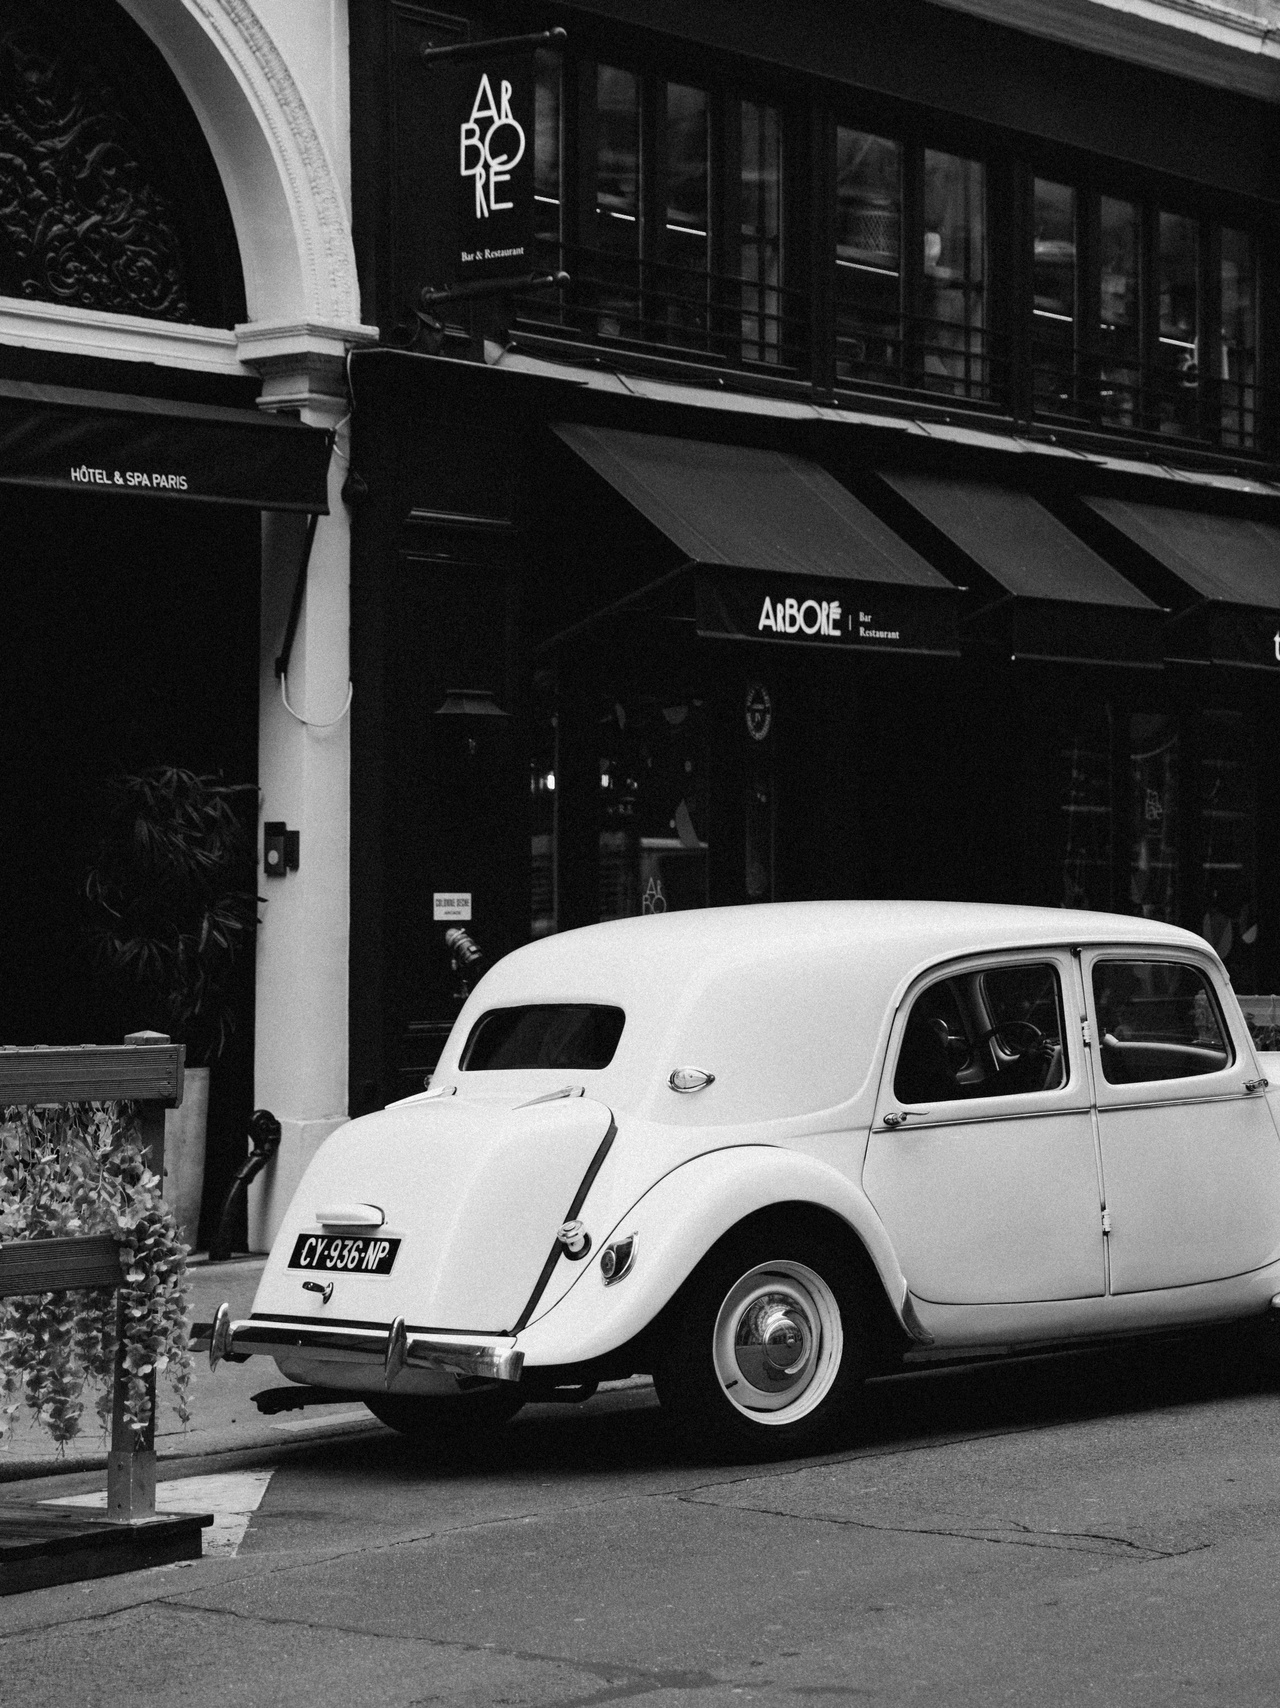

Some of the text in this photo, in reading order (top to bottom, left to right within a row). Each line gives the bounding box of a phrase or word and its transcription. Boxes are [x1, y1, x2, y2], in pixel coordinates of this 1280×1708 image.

[461, 247, 524, 262] Bar & Restaurant
[70, 464, 188, 490] HÔTEL & SPA PARIS
[859, 612, 872, 622] Bar
[859, 627, 900, 639] Restaurant
[300, 1237, 390, 1270] CY-936-NP
